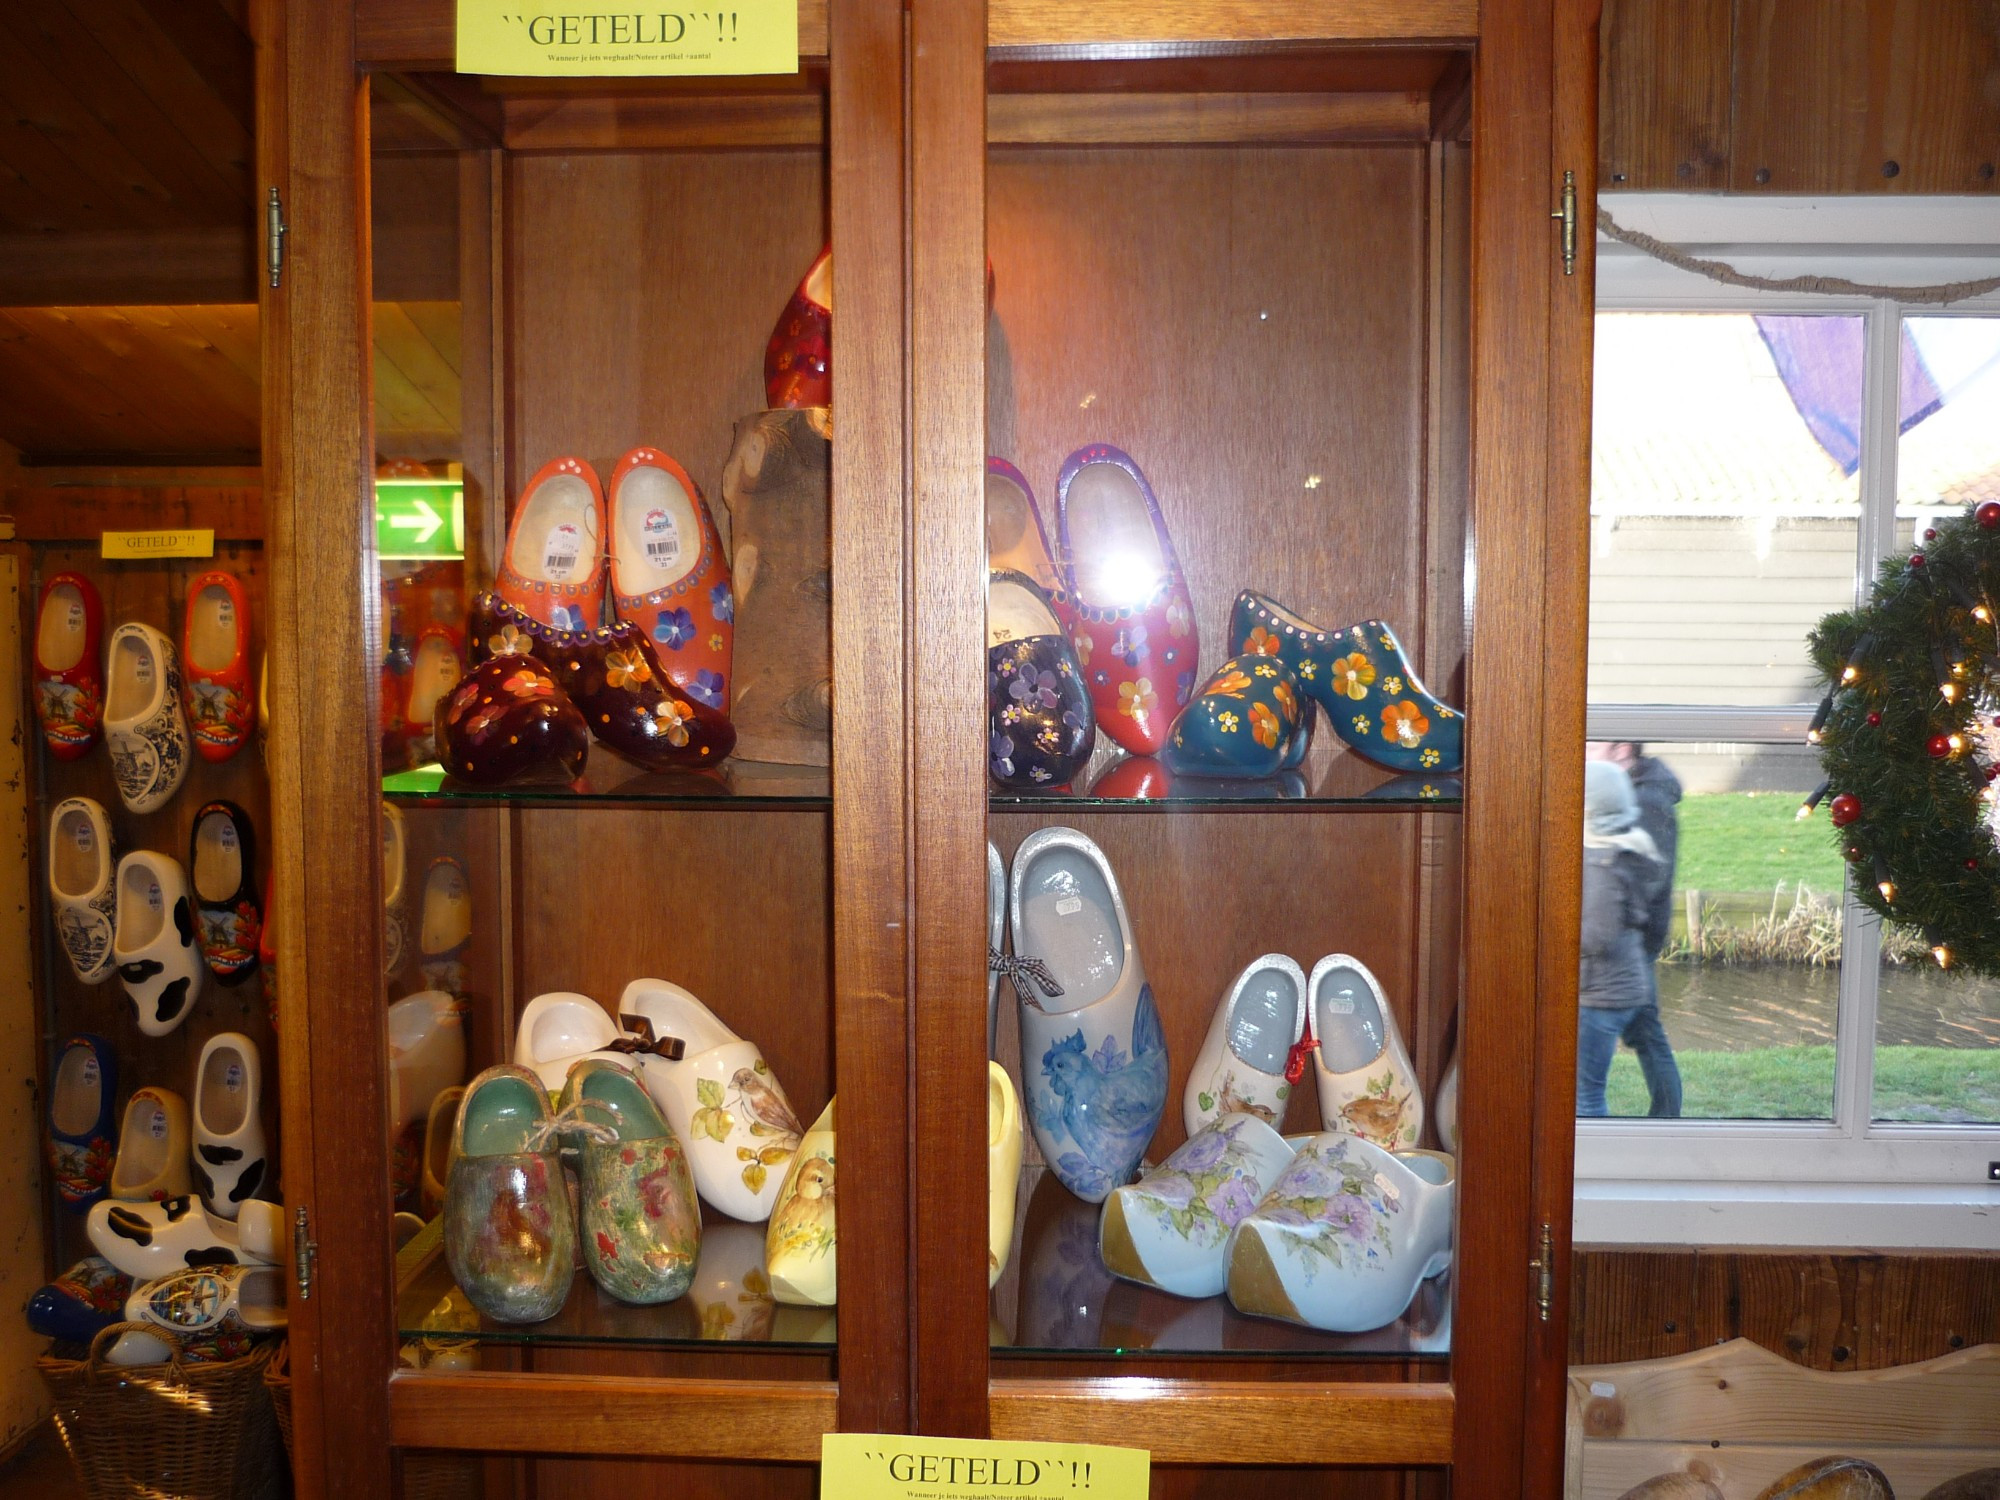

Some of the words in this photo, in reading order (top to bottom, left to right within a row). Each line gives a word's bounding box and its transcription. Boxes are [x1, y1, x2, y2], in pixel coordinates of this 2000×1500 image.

[547, 53, 579, 62] Wanneer
[581, 54, 588, 63] je
[589, 54, 601, 62] iets
[660, 52, 684, 61] artikel
[992, 629, 1011, 640] 24
